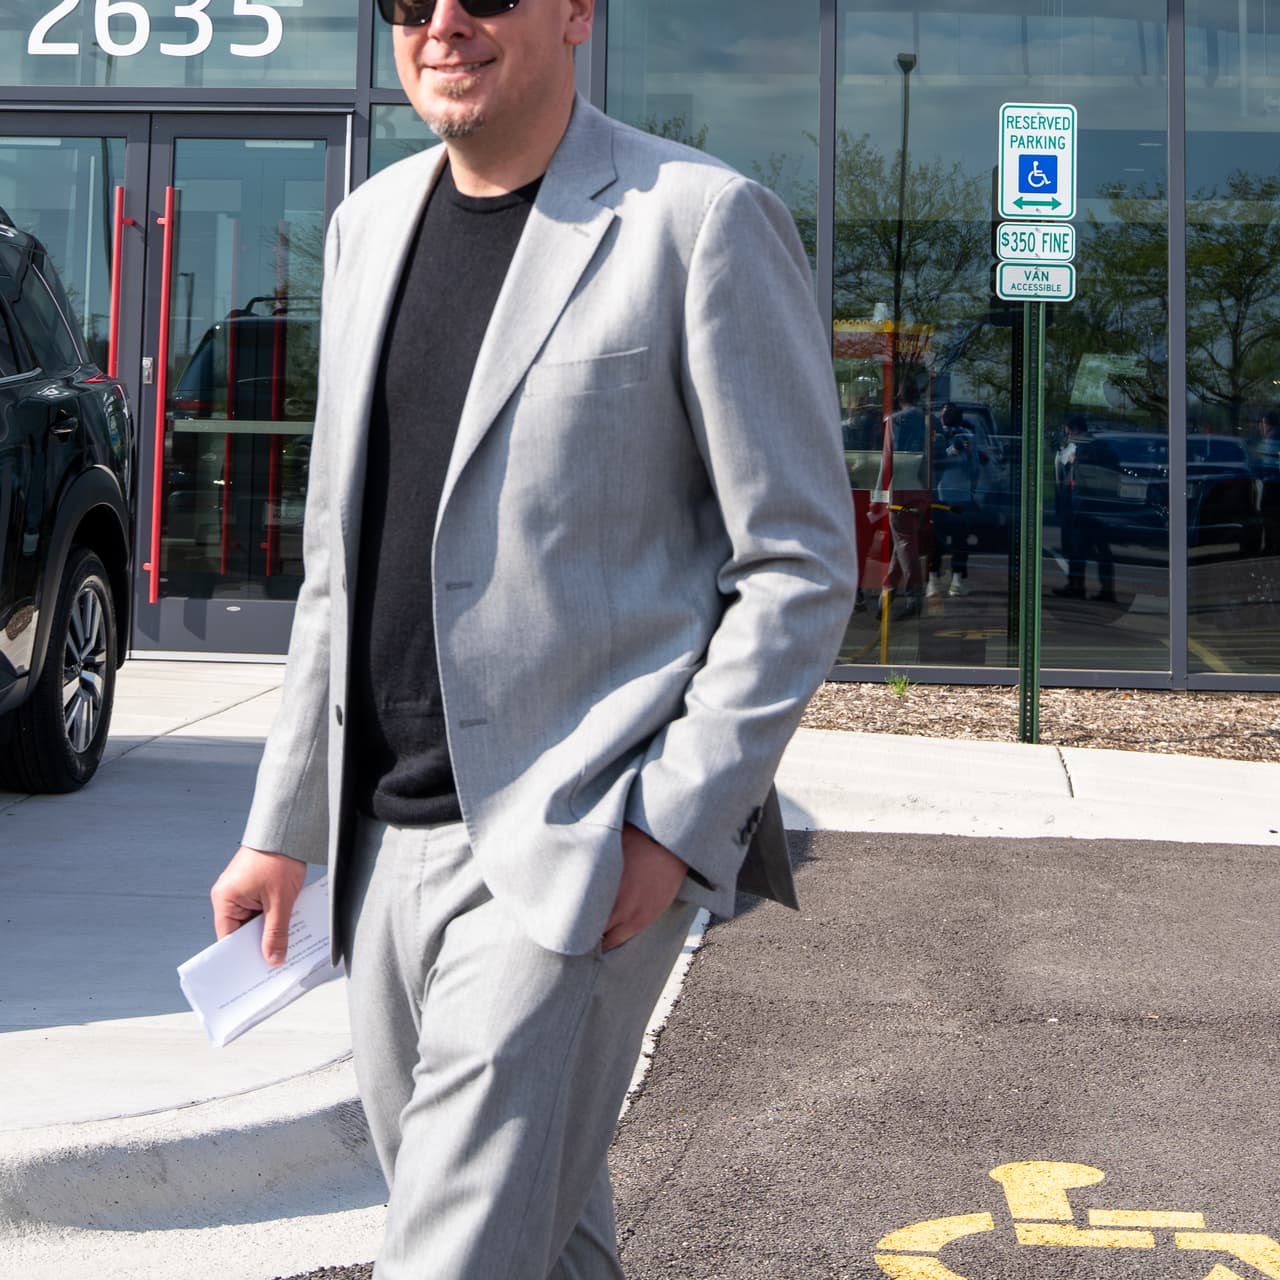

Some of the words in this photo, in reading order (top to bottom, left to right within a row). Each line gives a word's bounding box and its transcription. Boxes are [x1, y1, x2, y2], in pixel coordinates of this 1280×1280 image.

[1006, 115, 1071, 131] RESERVED
[1010, 135, 1066, 150] PARKING
[1001, 231, 1036, 253] $350
[1041, 232, 1070, 253] FINE
[1024, 270, 1049, 282] VAN
[1010, 283, 1062, 293] ACCESSIBLE
